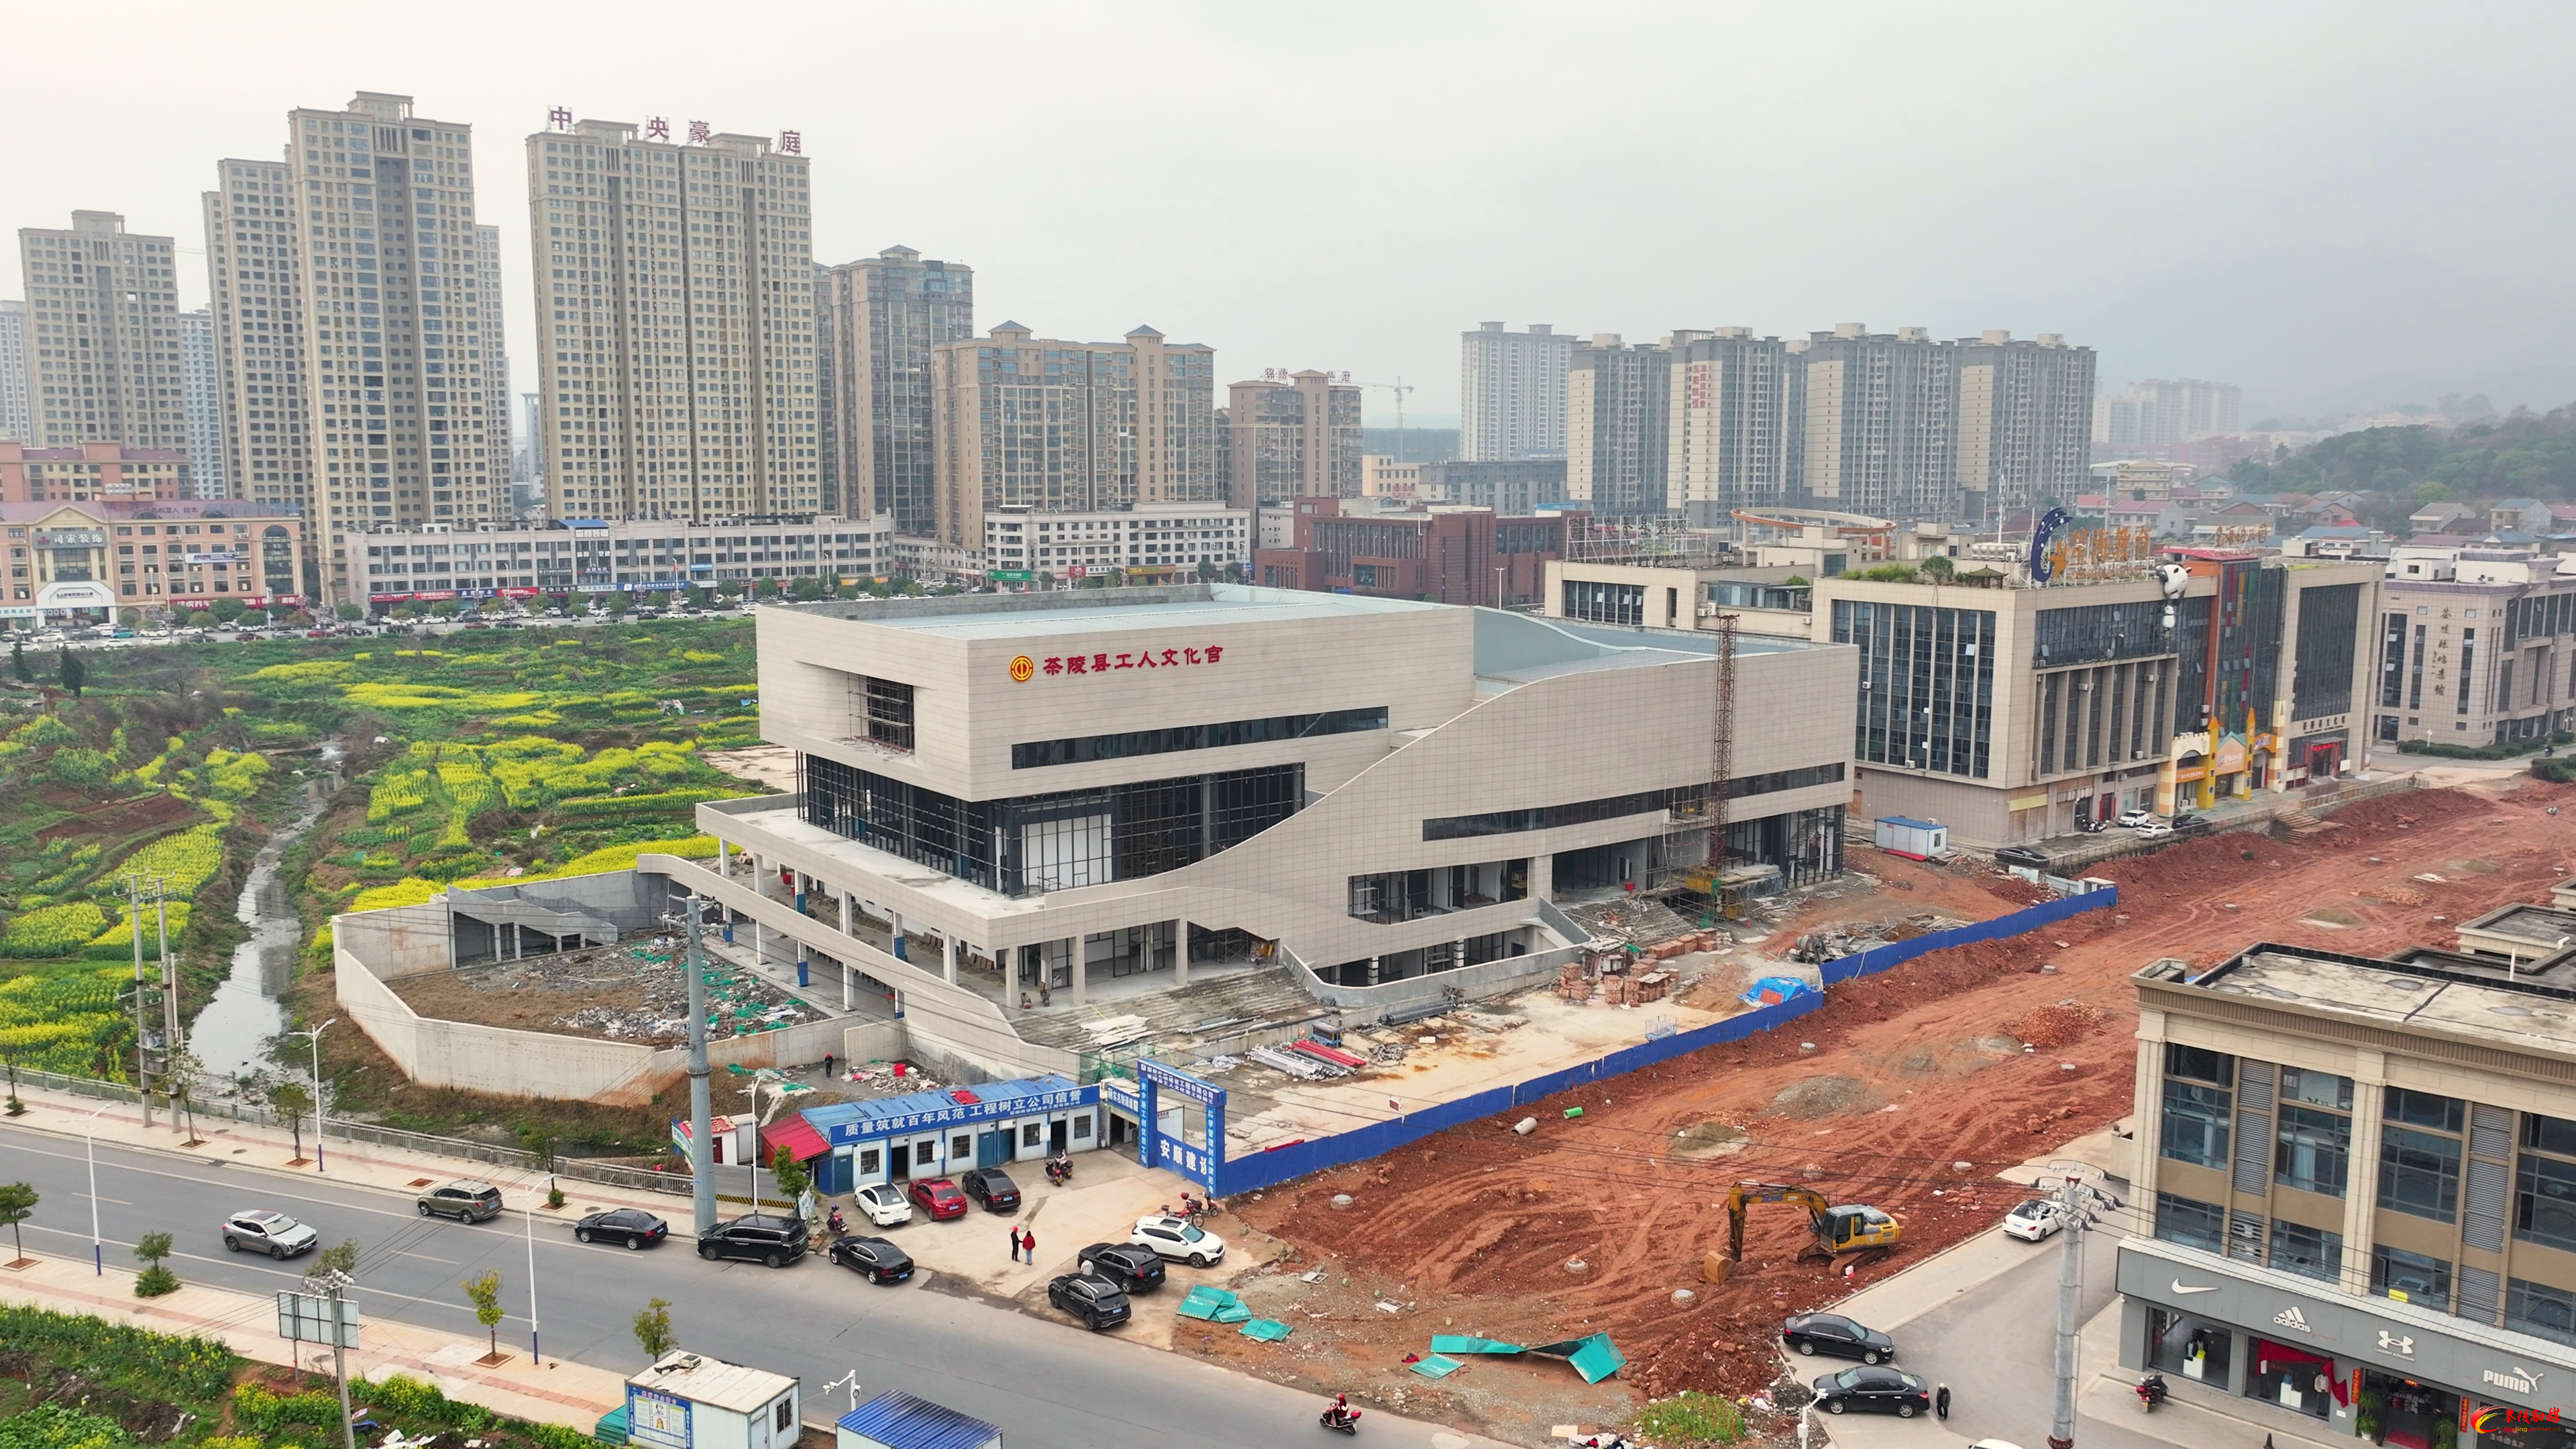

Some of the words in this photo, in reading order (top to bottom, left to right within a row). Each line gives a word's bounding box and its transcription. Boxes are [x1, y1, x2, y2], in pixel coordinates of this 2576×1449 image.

[550, 105, 802, 154] 中央豪庭
[1265, 367, 1350, 382] 锦绣华府
[2071, 525, 2151, 564] 星海教育
[1042, 645, 1224, 676] 茶陵县工人文化宫
[1147, 1063, 1214, 1099] 湖南安顺建设工程有限公司
[845, 1108, 965, 1136] 质量筑就百年风范
[969, 1089, 1082, 1116] 工程树立公司信誉
[1160, 1138, 1207, 1176] 安顺建设
[2273, 1316, 2312, 1333] adidas
[2483, 1369, 2530, 1395] PUMA
